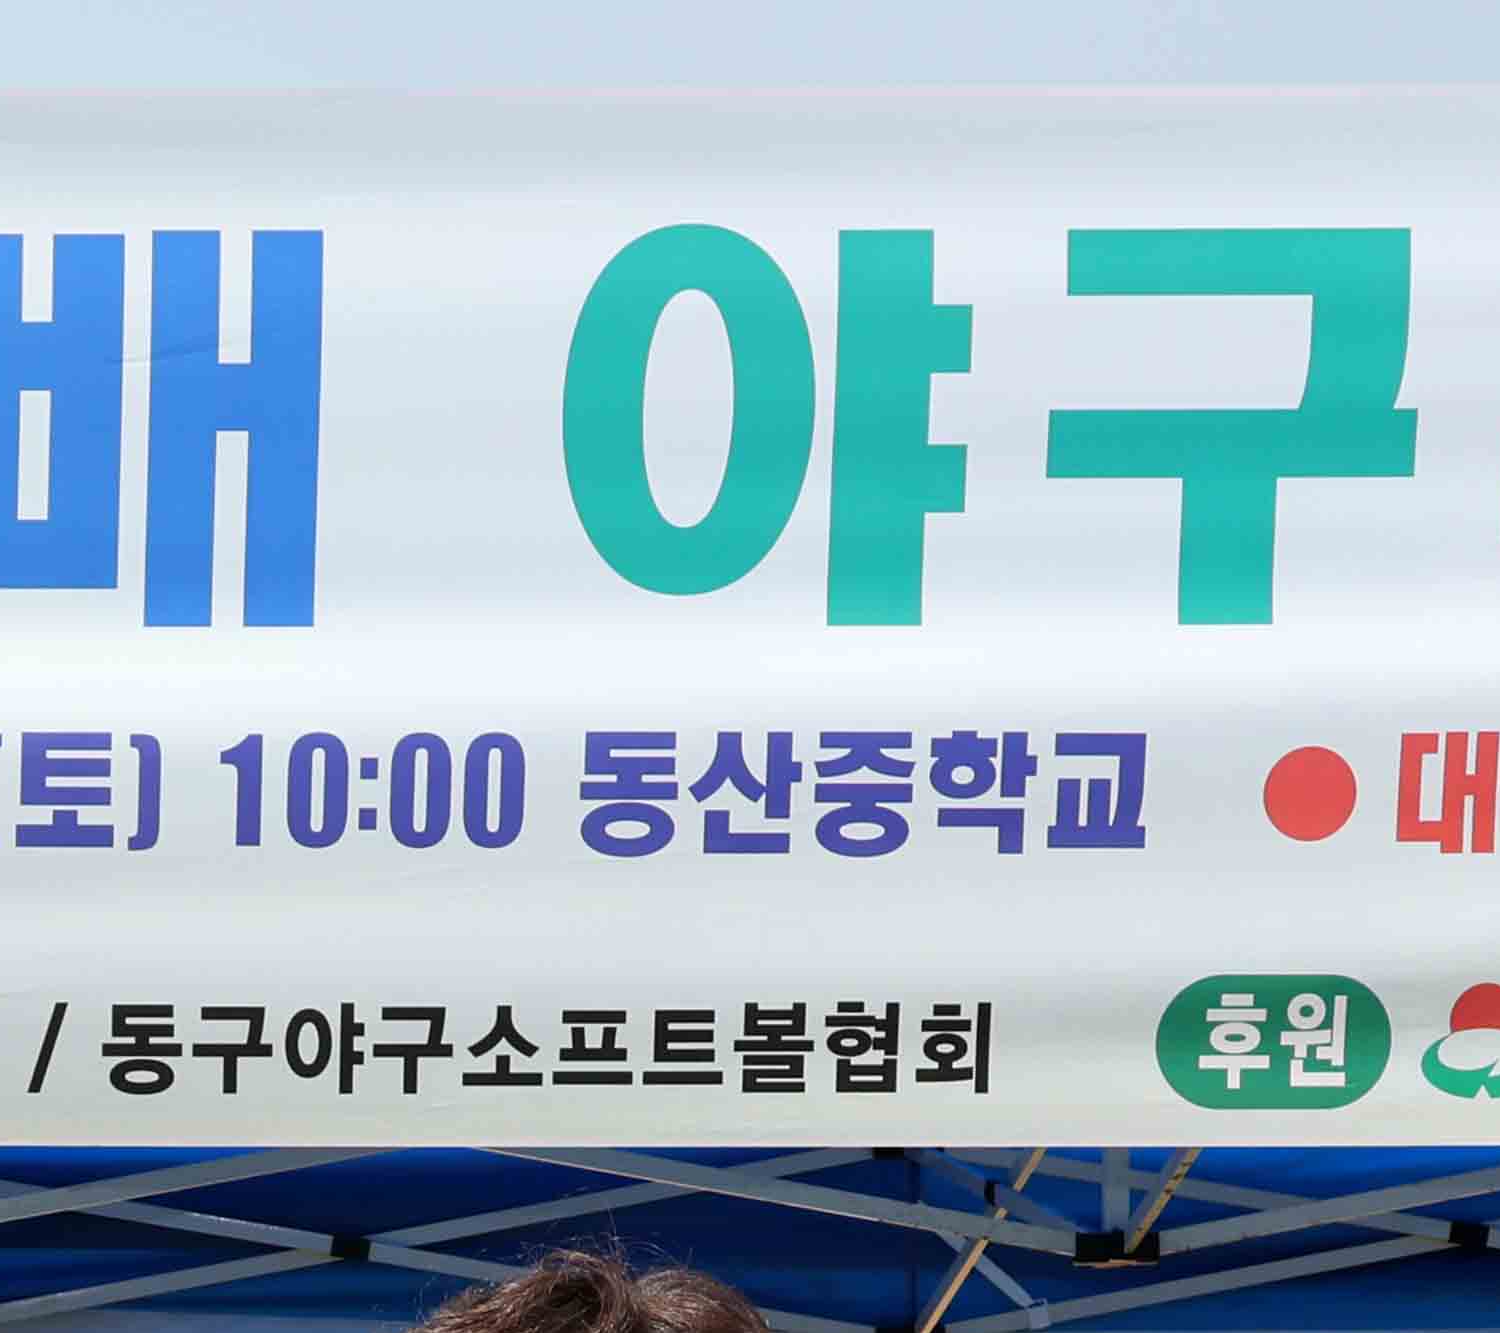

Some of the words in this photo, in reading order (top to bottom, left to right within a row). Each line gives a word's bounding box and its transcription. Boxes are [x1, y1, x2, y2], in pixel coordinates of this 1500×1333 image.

[220, 731, 525, 849] 10:00
[578, 730, 1148, 857] 동산중학교
[27, 1000, 70, 1096] /
[99, 999, 995, 1098] 동구야구소프트볼협회
[1193, 992, 1349, 1090] 후원
